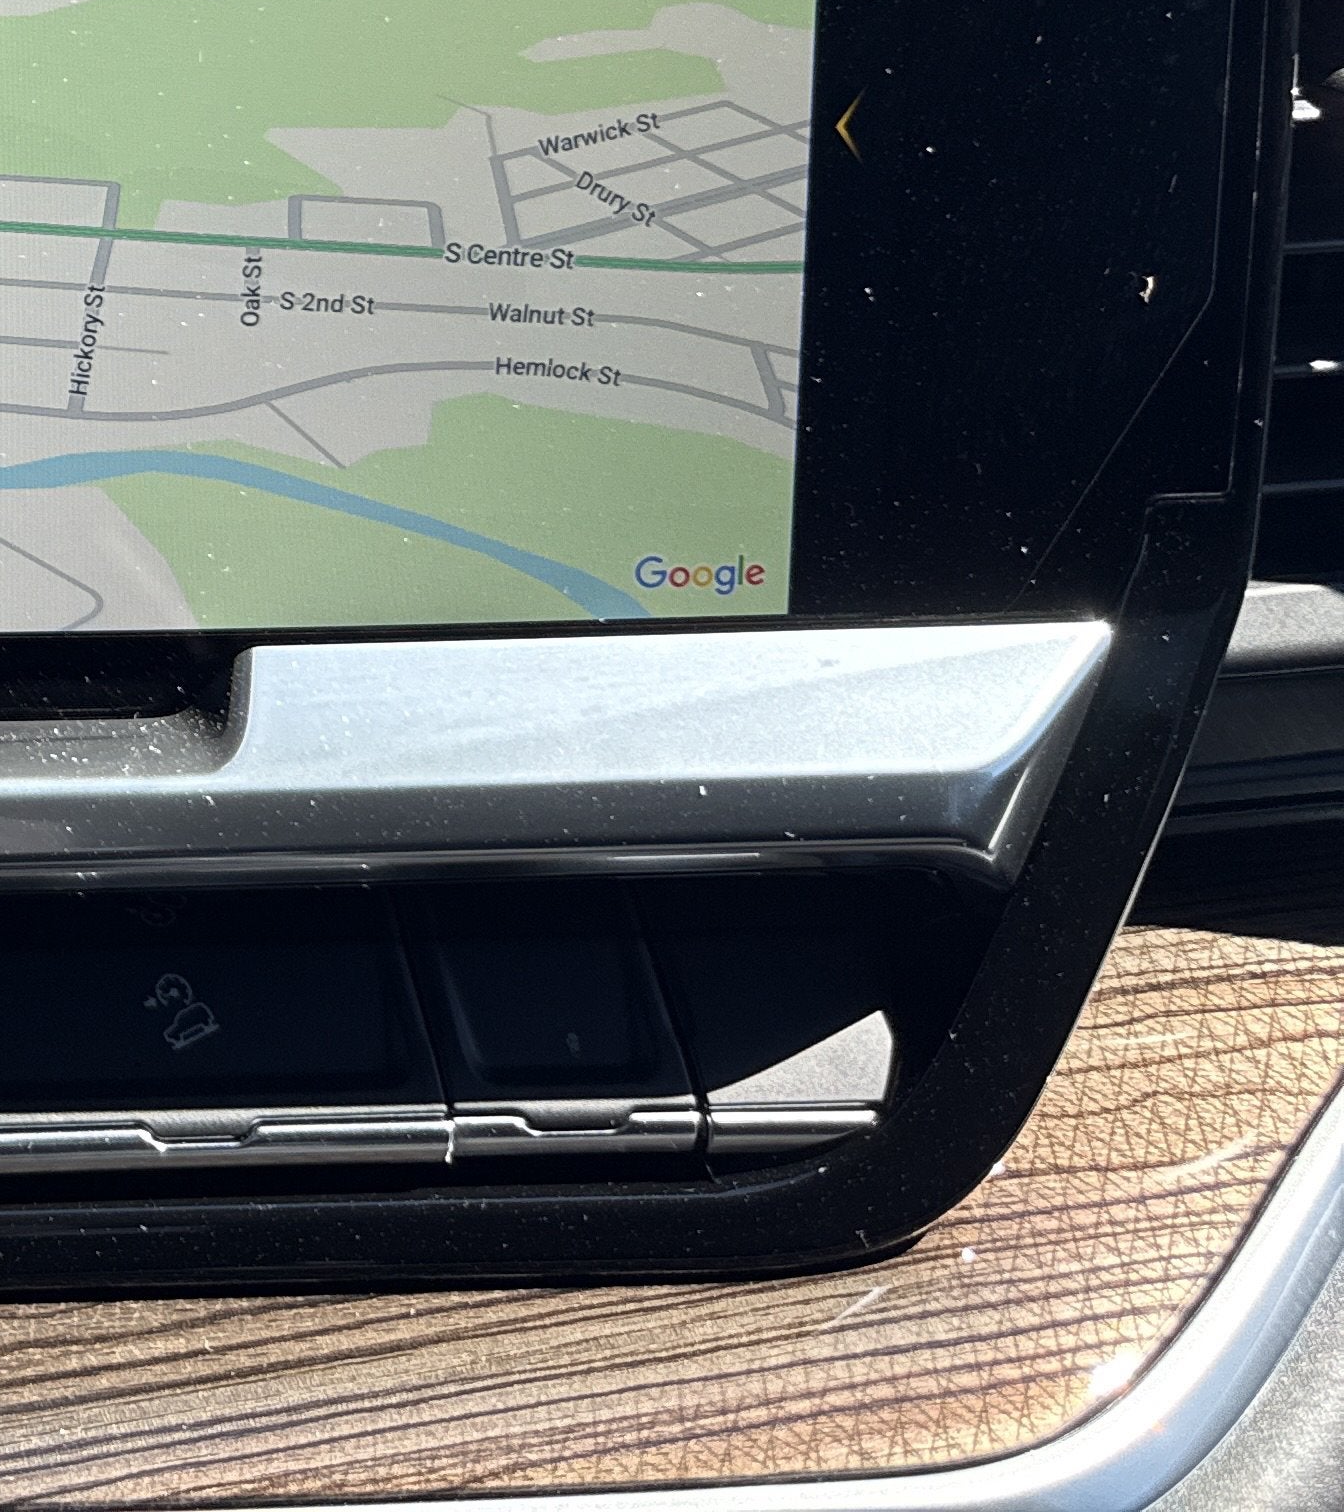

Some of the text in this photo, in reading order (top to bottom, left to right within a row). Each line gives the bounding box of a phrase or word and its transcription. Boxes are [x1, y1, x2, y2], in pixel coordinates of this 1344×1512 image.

[538, 113, 661, 156] Warwick St
[575, 170, 656, 226] Drury St
[445, 244, 574, 269] S Centre St
[241, 256, 261, 327] Oak St
[280, 292, 375, 315] S 2nd St
[489, 304, 595, 327] Walnut St
[69, 285, 105, 396] Hickory St
[495, 356, 621, 387] Hemlock St
[635, 555, 766, 595] Google
